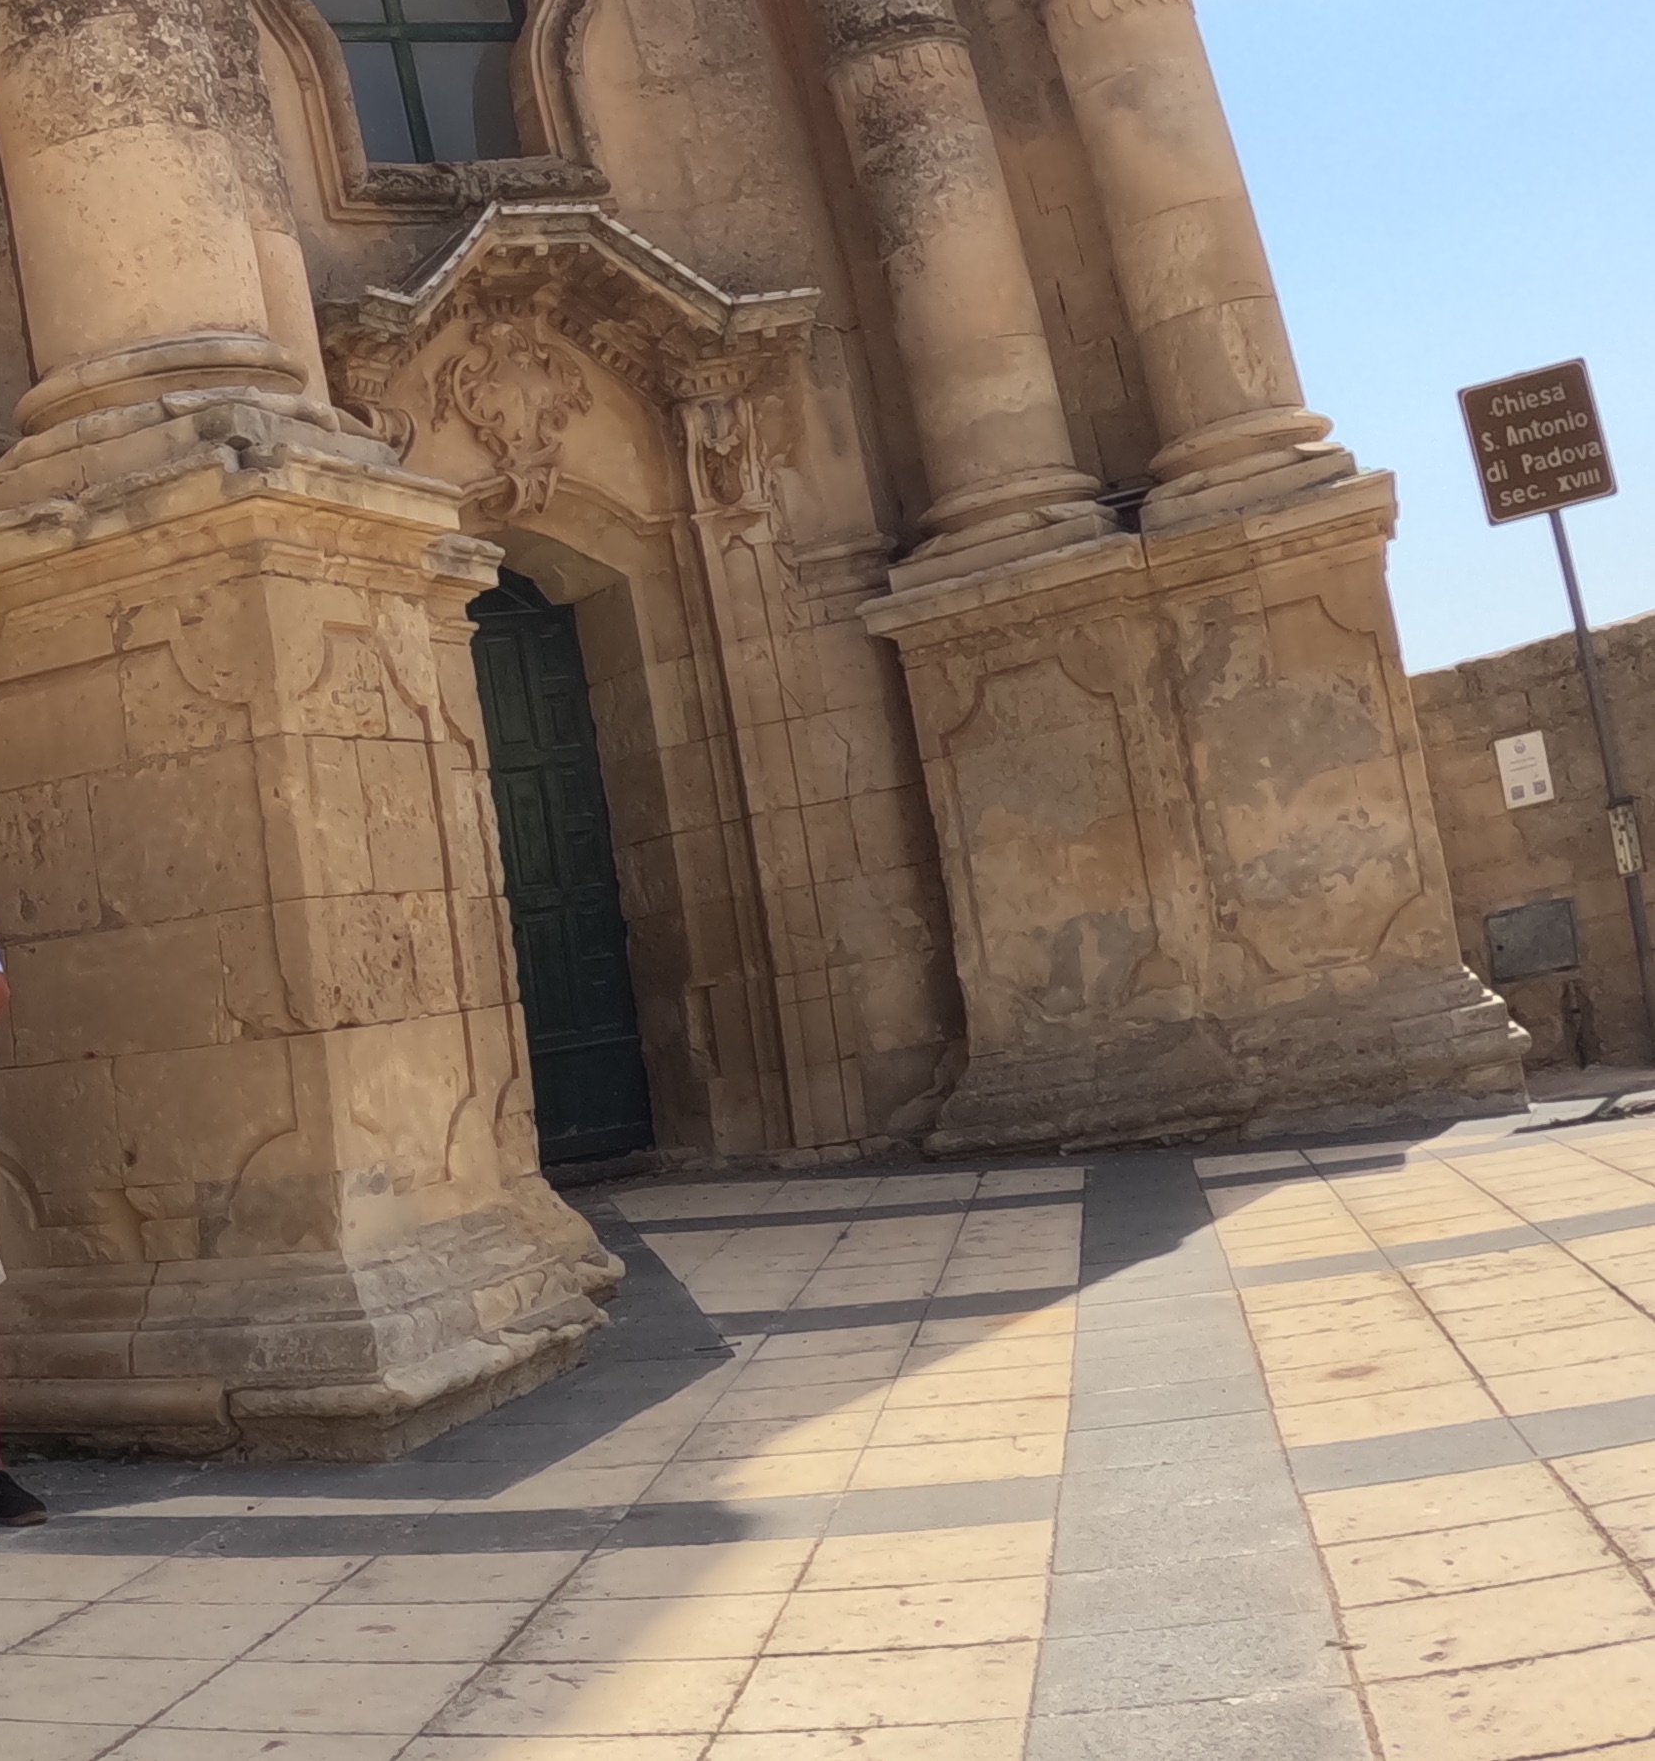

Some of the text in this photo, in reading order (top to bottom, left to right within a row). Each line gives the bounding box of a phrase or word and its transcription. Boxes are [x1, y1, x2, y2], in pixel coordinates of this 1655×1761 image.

[1491, 385, 1566, 417] Chiesa
[1481, 410, 1588, 452] S. Antonio
[1486, 441, 1603, 483] di Padova
[1499, 468, 1601, 507] sec. XVIII
